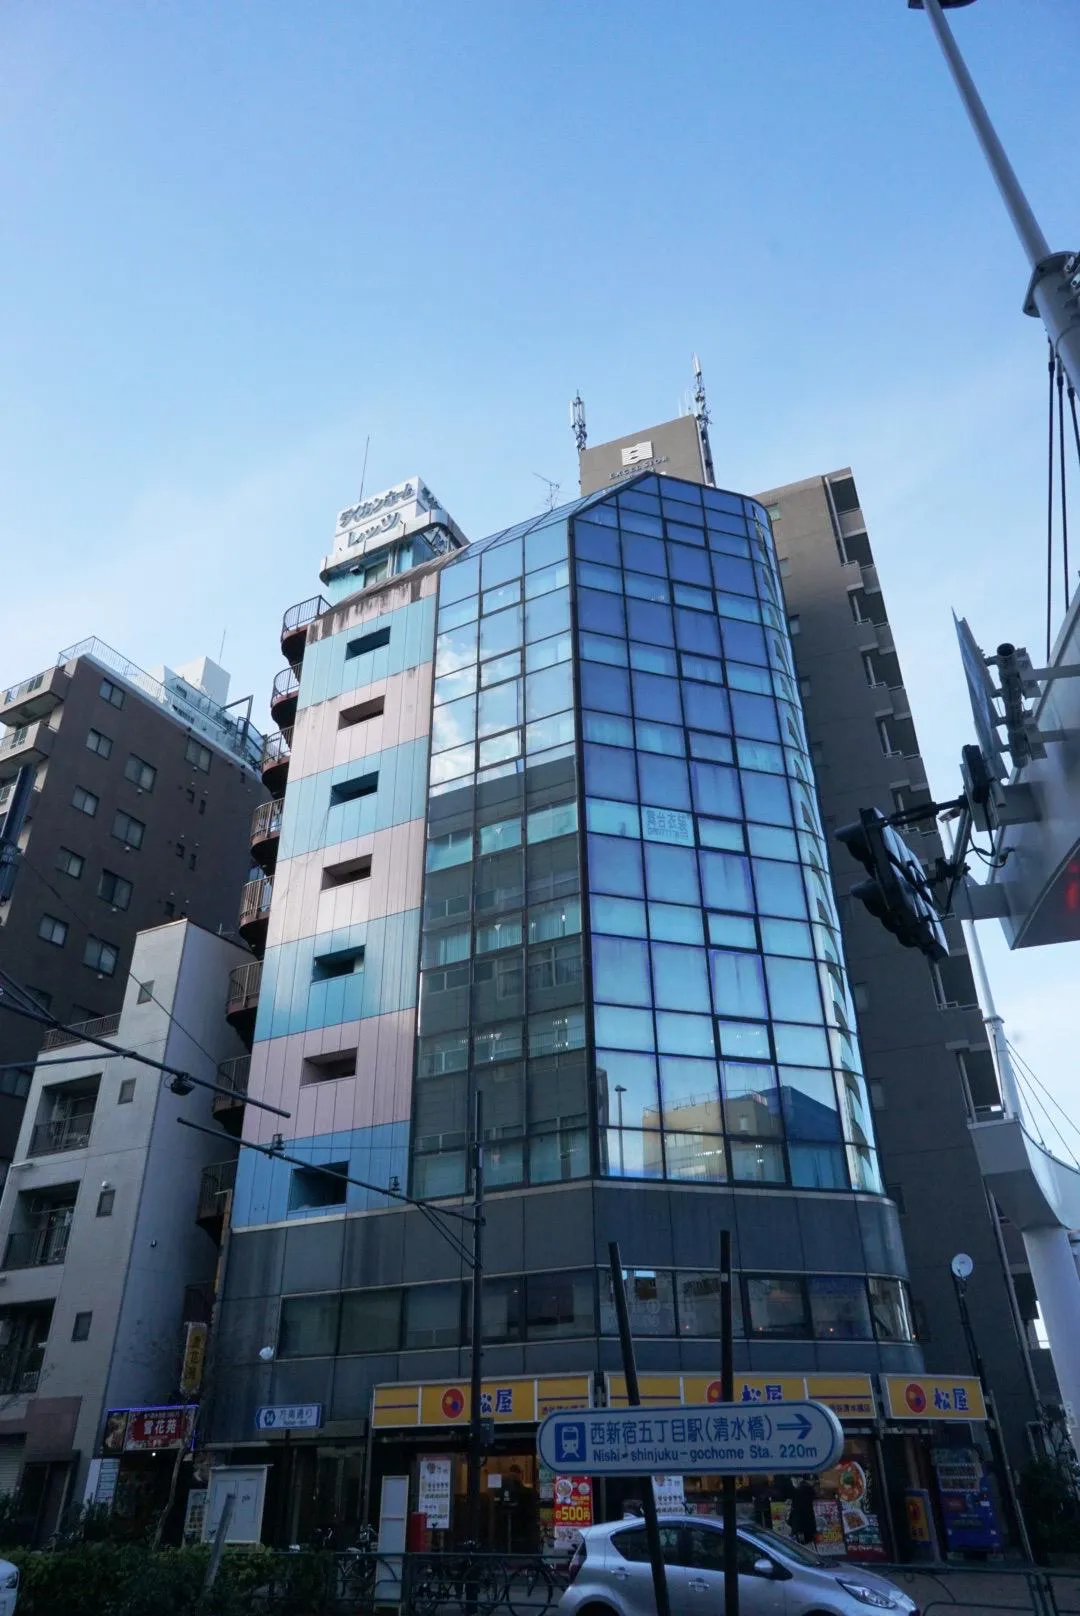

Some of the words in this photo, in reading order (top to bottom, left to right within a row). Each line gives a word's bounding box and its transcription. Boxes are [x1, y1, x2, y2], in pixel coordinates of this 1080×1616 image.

[347, 511, 401, 547] レッツ
[932, 1387, 970, 1411] 松屋
[590, 1415, 773, 1445] 西新宿五丁目駅(清水橋)
[749, 1446, 774, 1459] Sta.
[779, 1443, 818, 1459] 220m
